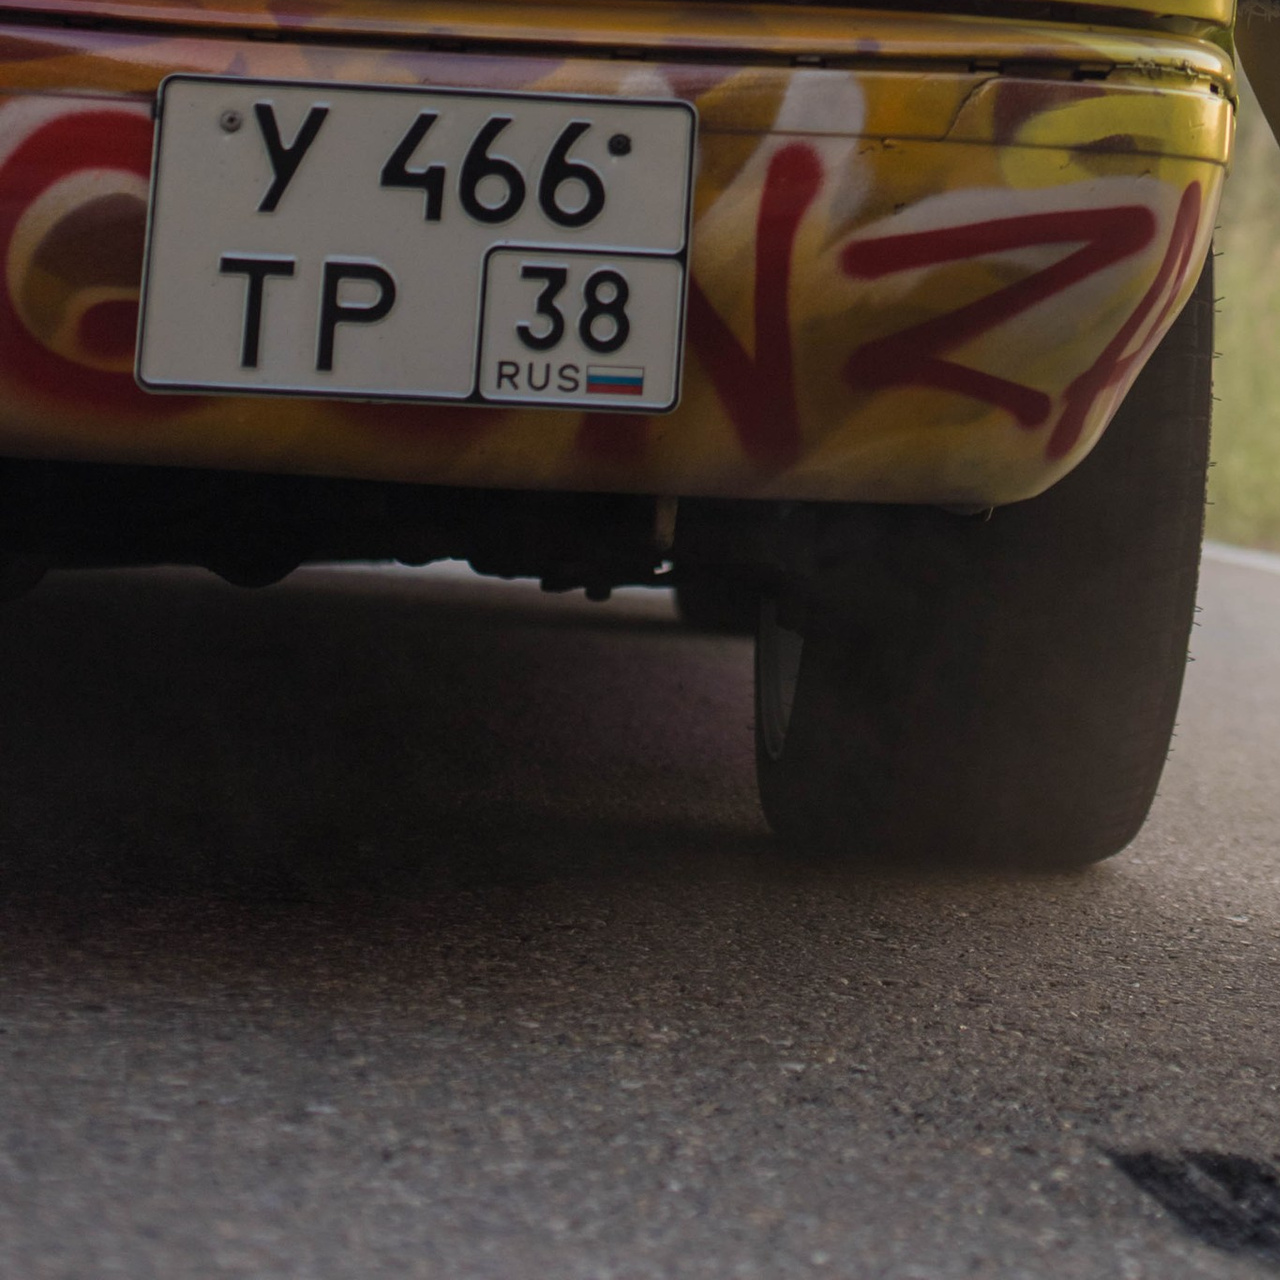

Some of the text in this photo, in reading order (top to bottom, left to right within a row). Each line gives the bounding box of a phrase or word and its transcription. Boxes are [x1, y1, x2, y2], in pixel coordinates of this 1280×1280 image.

[380, 112, 606, 228] 466
[516, 265, 631, 354] 38
[496, 361, 581, 393] RUS
